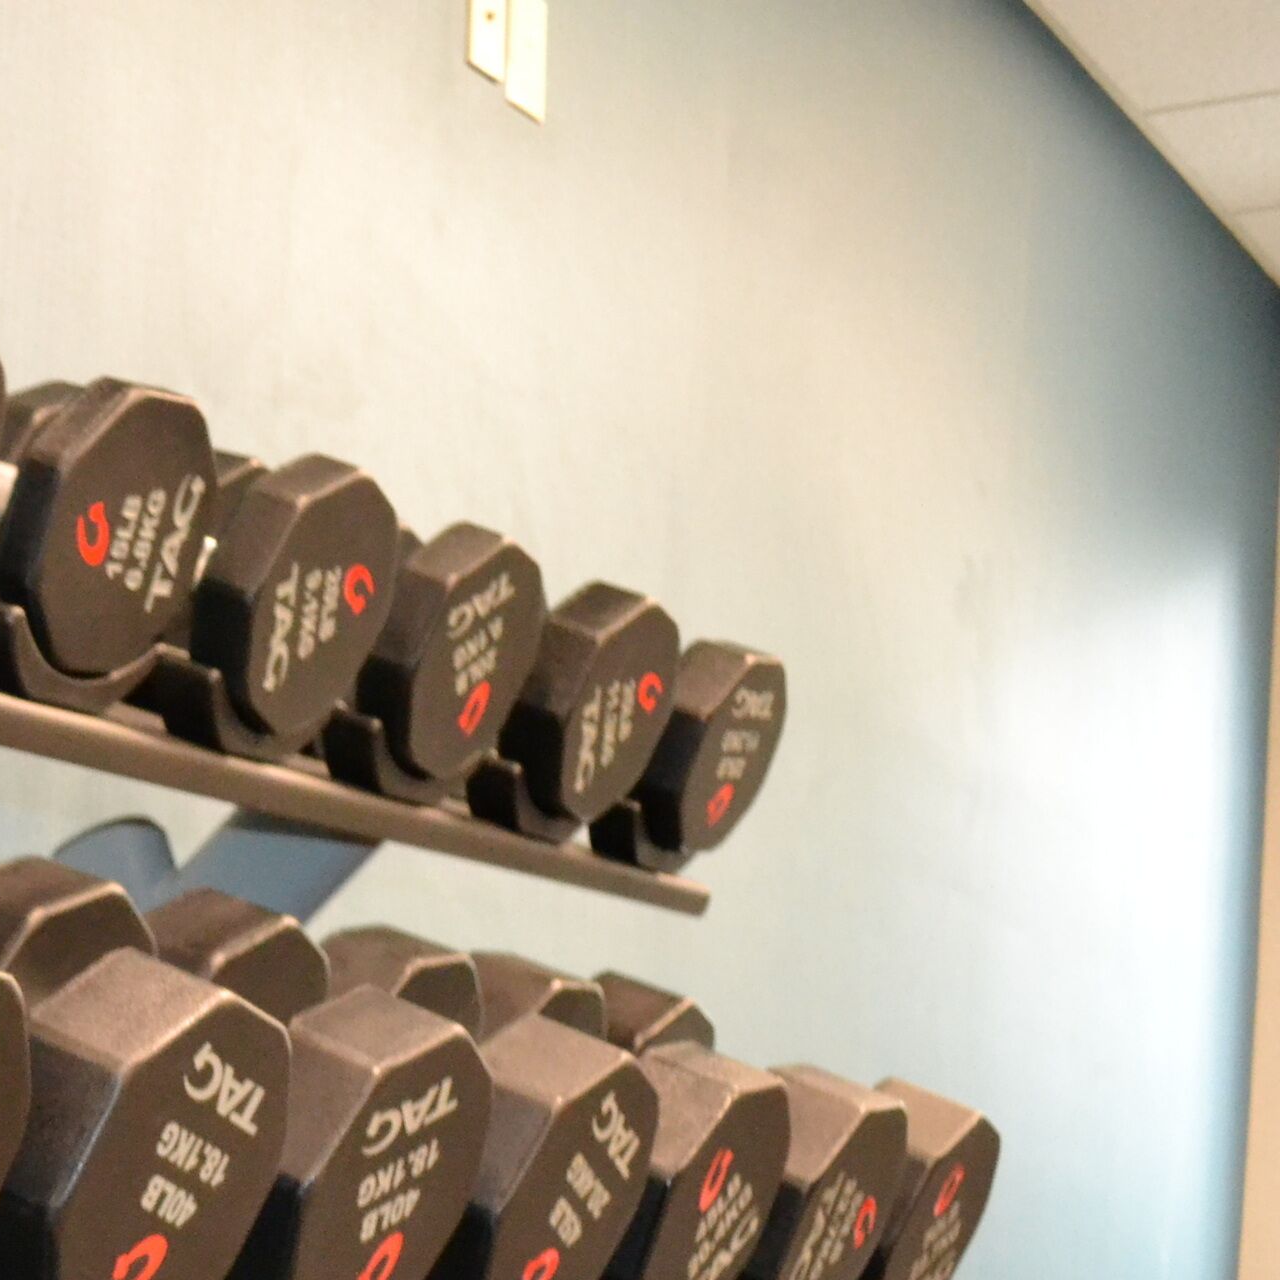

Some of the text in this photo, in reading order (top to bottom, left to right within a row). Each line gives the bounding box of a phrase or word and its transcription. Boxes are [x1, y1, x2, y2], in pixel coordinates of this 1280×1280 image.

[143, 474, 206, 613] TAG
[262, 561, 300, 692] TAG
[446, 571, 516, 640] TAG
[183, 1040, 266, 1137] TAG
[360, 1075, 459, 1157] TAG
[155, 1120, 230, 1188] 18.1KG
[356, 1137, 440, 1209] 18.1KG
[591, 1089, 640, 1181] TAG
[140, 1173, 198, 1229] 40LB
[359, 1188, 421, 1244] 40LB
